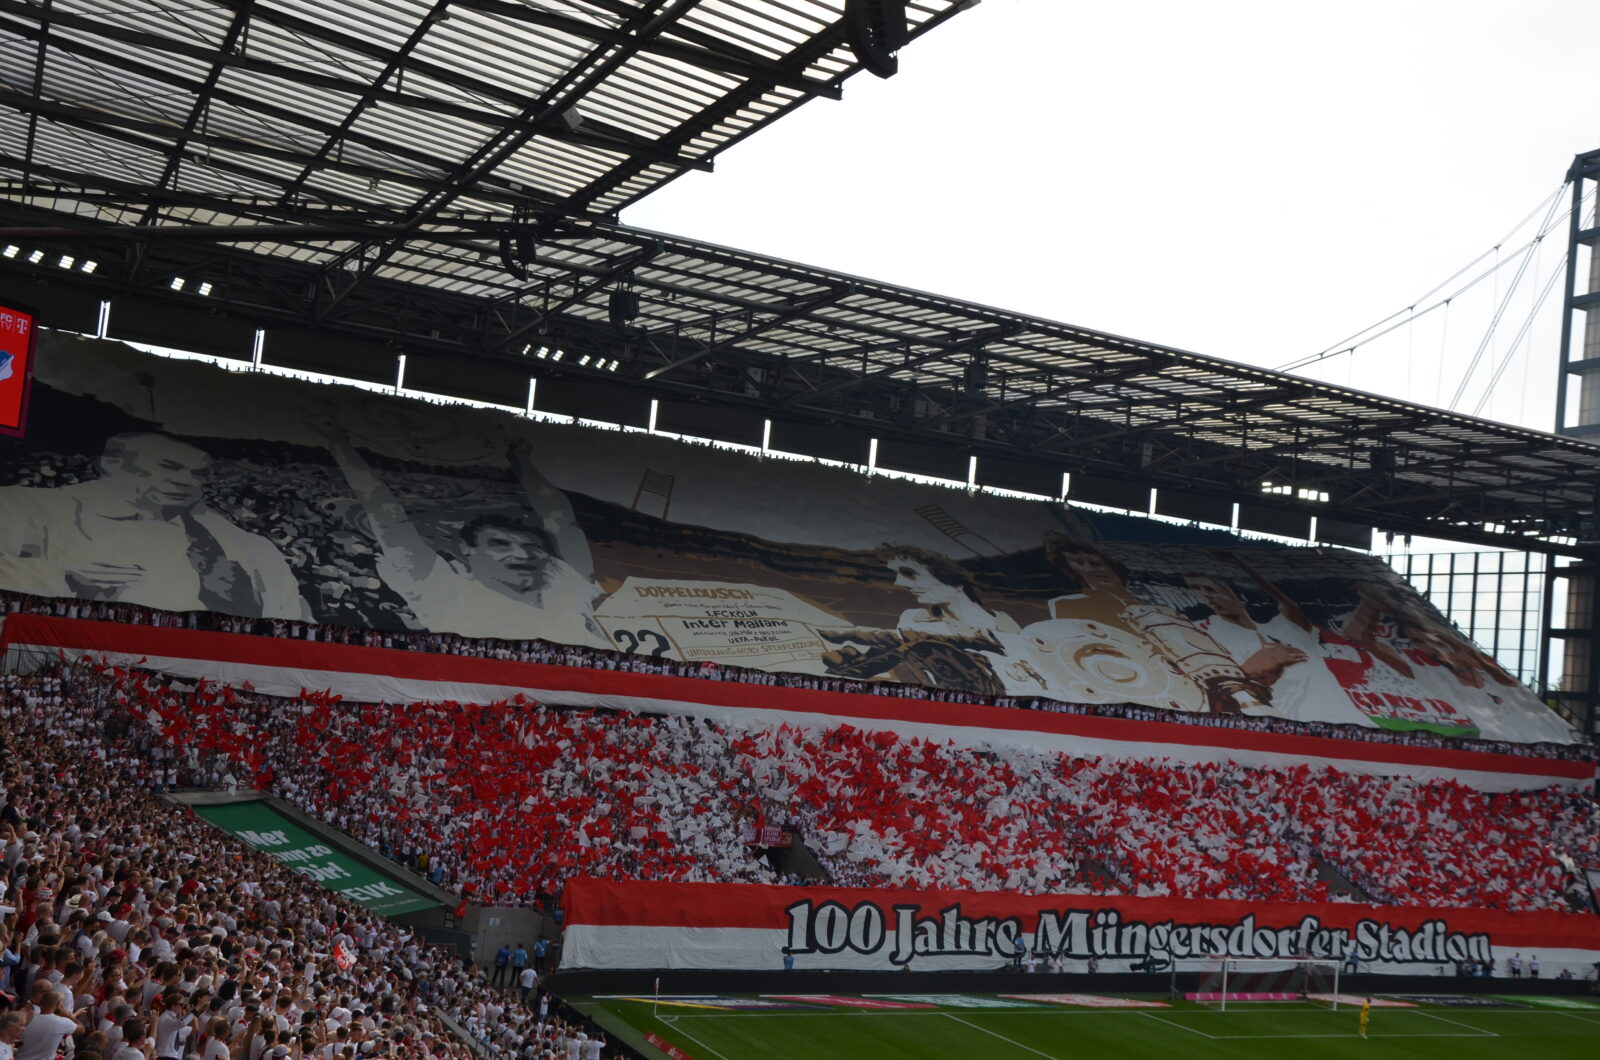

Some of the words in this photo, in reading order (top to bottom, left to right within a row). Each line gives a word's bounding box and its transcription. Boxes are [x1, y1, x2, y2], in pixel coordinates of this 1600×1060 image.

[235, 830, 290, 847] Mer
[304, 845, 333, 858] zo
[297, 861, 352, 882] Dir!
[782, 900, 885, 954] 100
[889, 903, 1024, 964] Jahre
[1033, 908, 1350, 974] Müngersdorfer
[1354, 917, 1496, 964] Stadion
